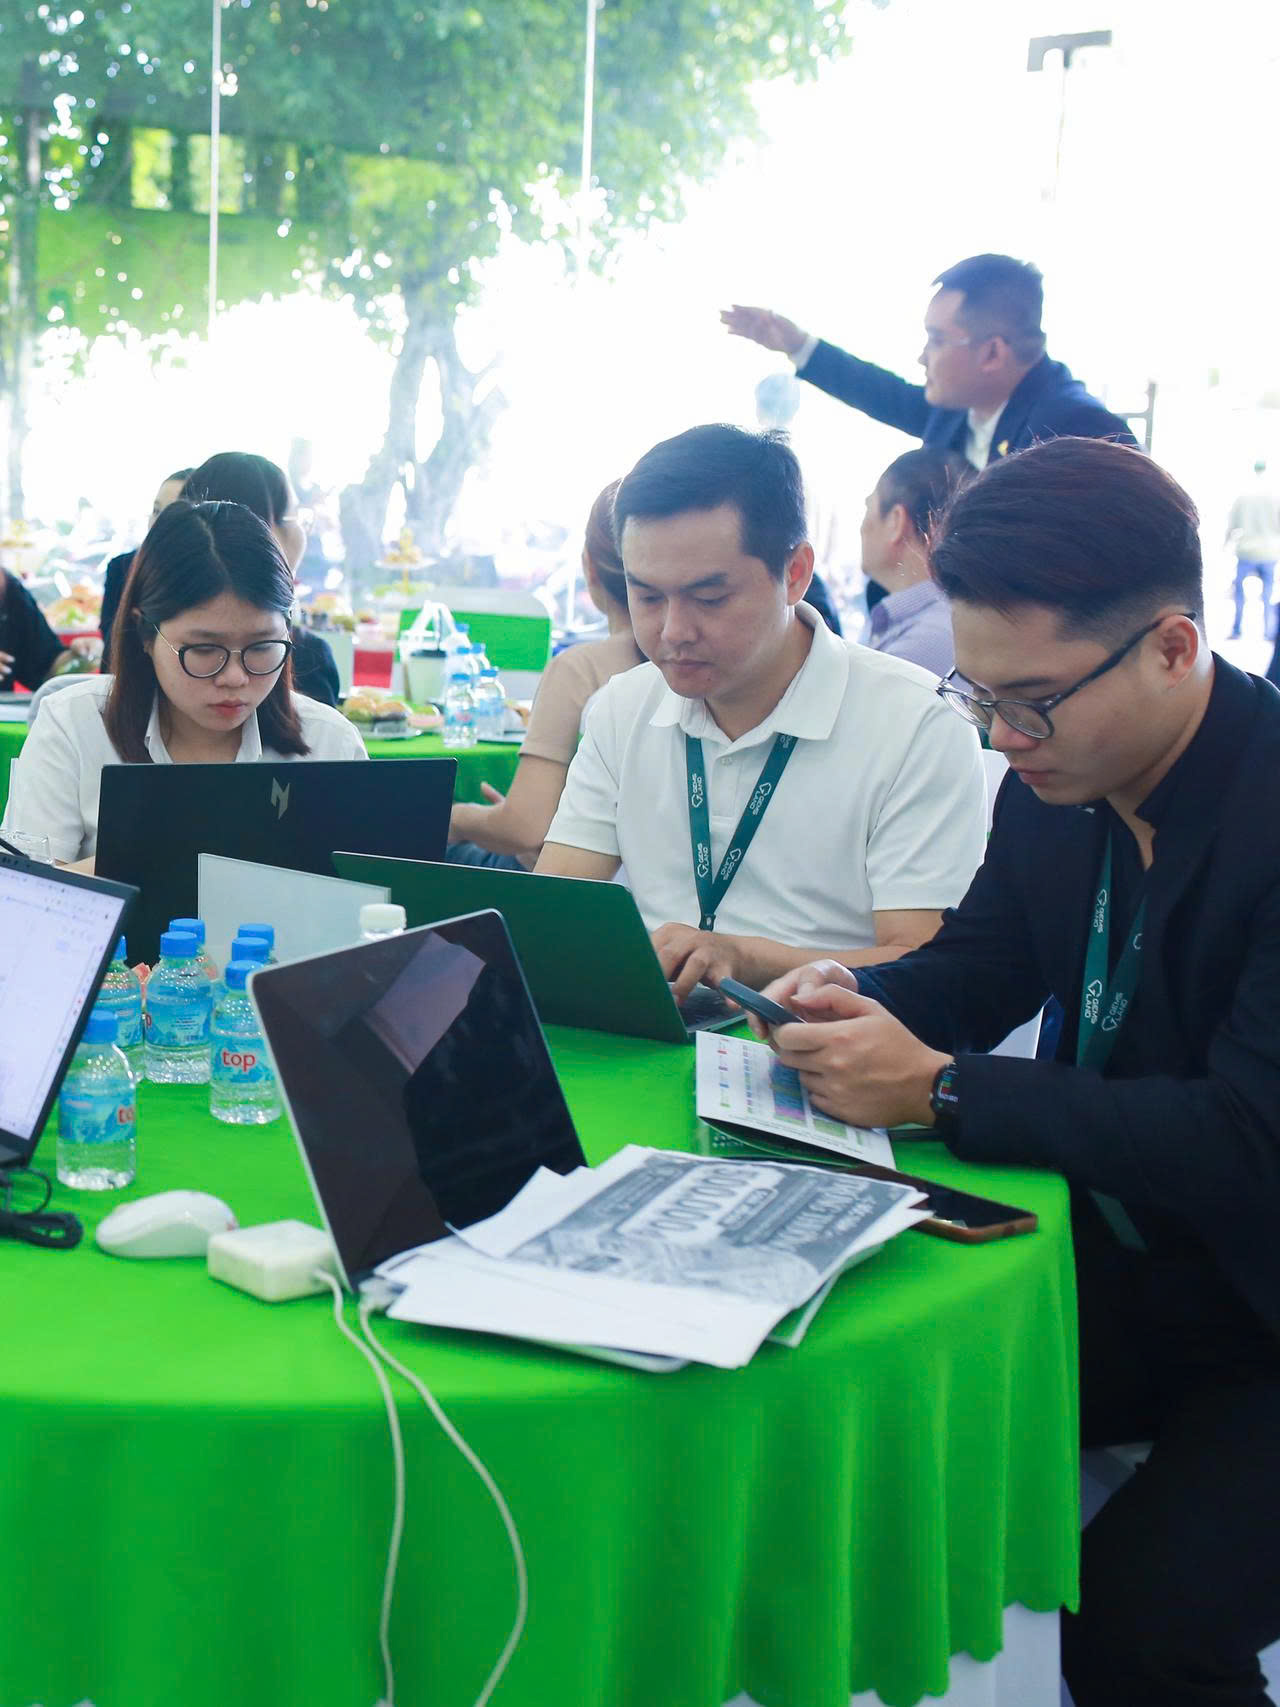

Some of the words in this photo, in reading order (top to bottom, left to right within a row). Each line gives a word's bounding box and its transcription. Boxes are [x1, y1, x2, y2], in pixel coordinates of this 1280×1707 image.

[749, 791, 760, 810] LAND
[1084, 993, 1092, 1018] LAND
[222, 1050, 256, 1072] top
[117, 1107, 135, 1124] to
